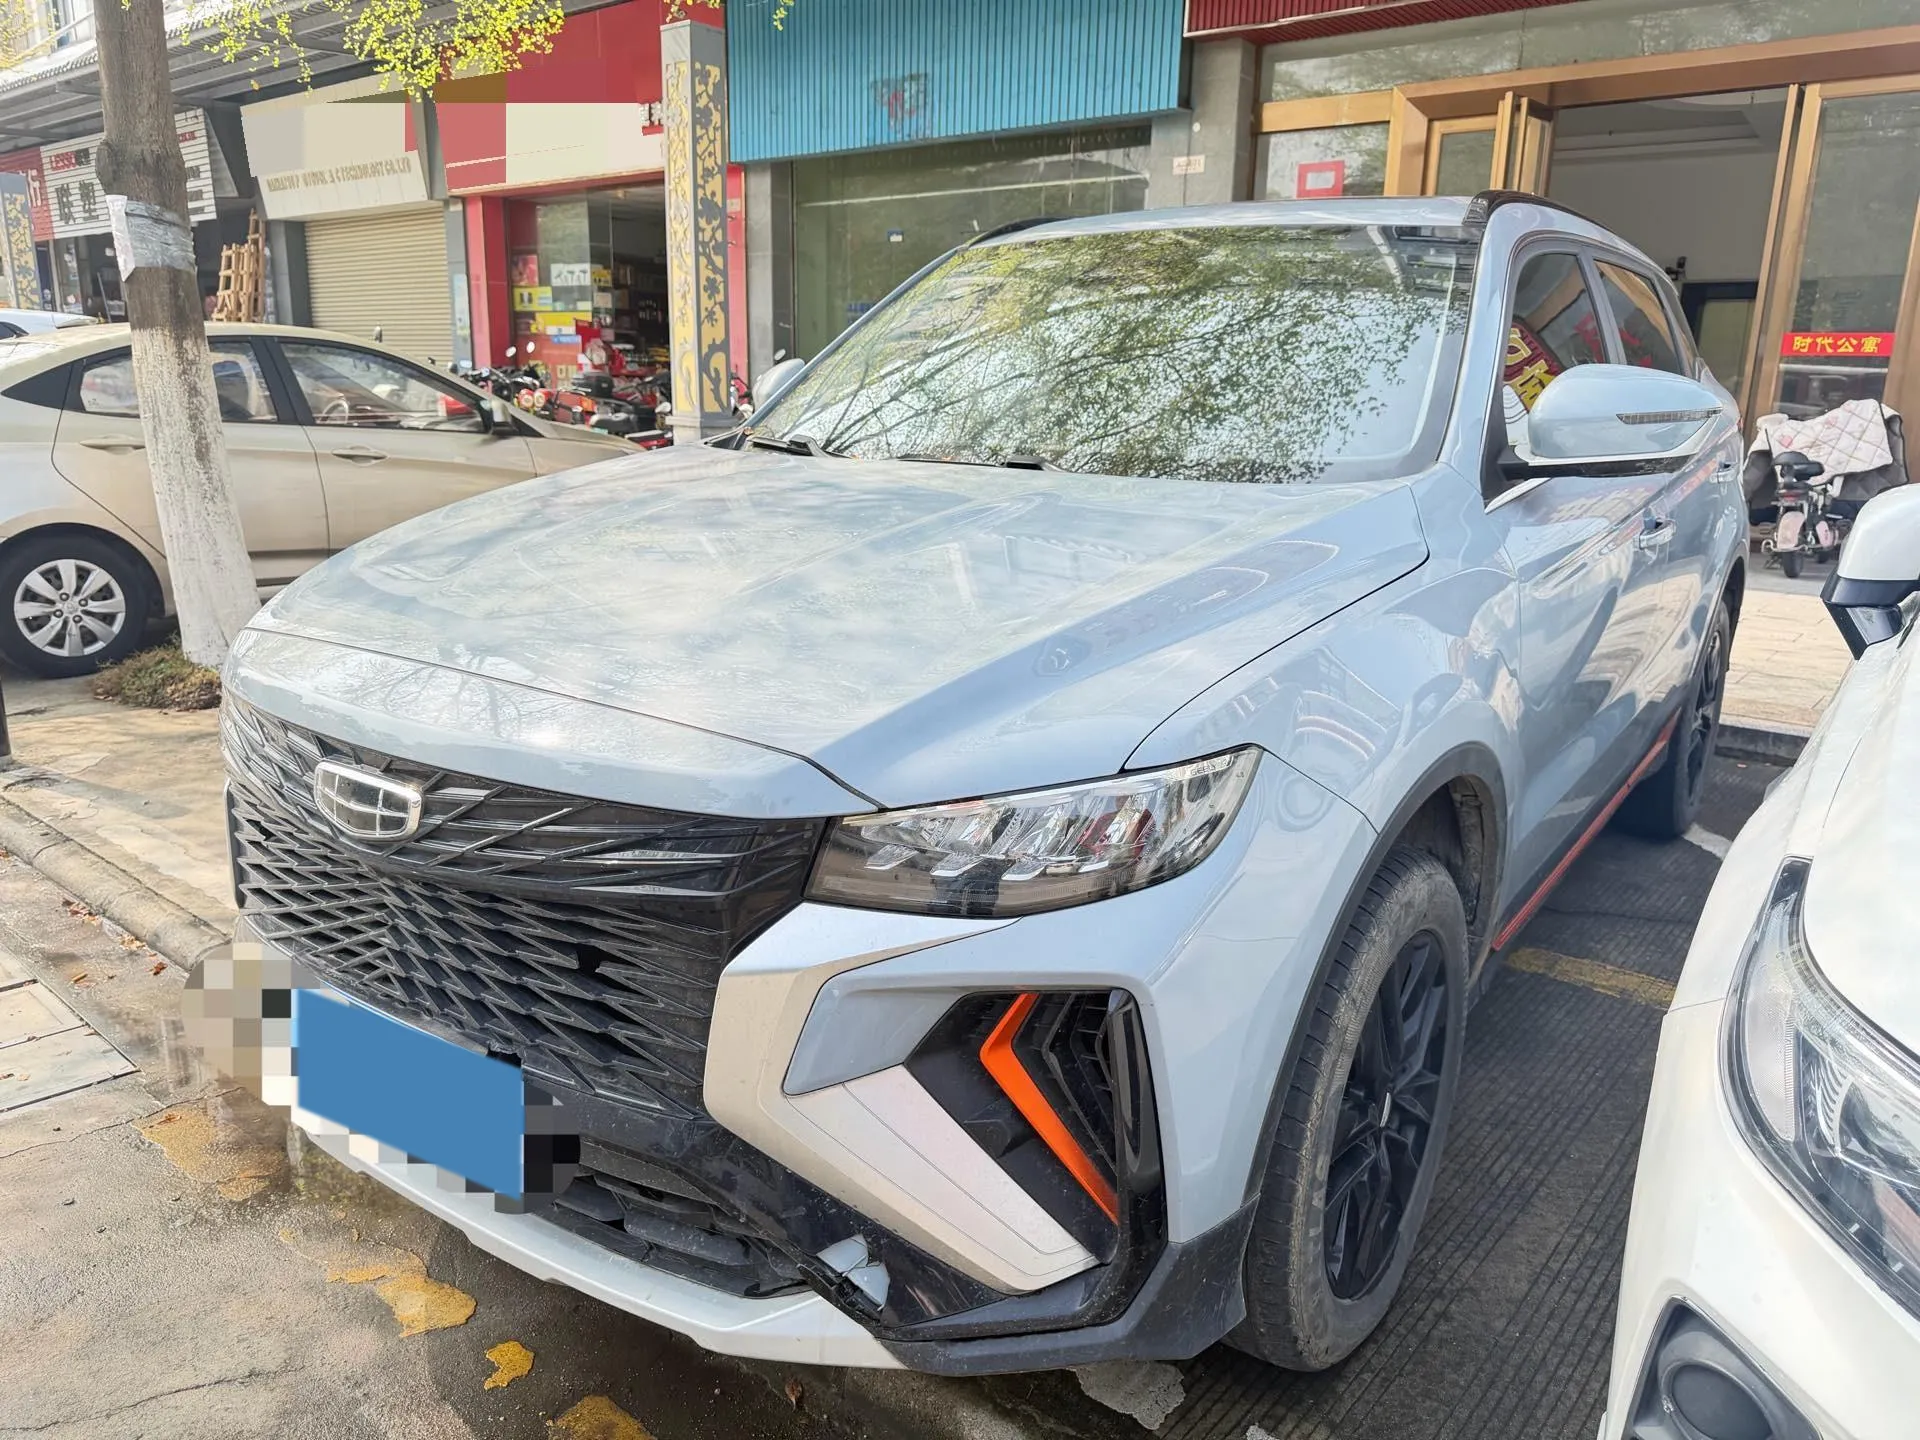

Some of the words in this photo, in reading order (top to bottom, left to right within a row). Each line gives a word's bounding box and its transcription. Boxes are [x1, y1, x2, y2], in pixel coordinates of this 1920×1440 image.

[55, 180, 100, 224] 联塑
[1792, 336, 1881, 354] 时代公寓
